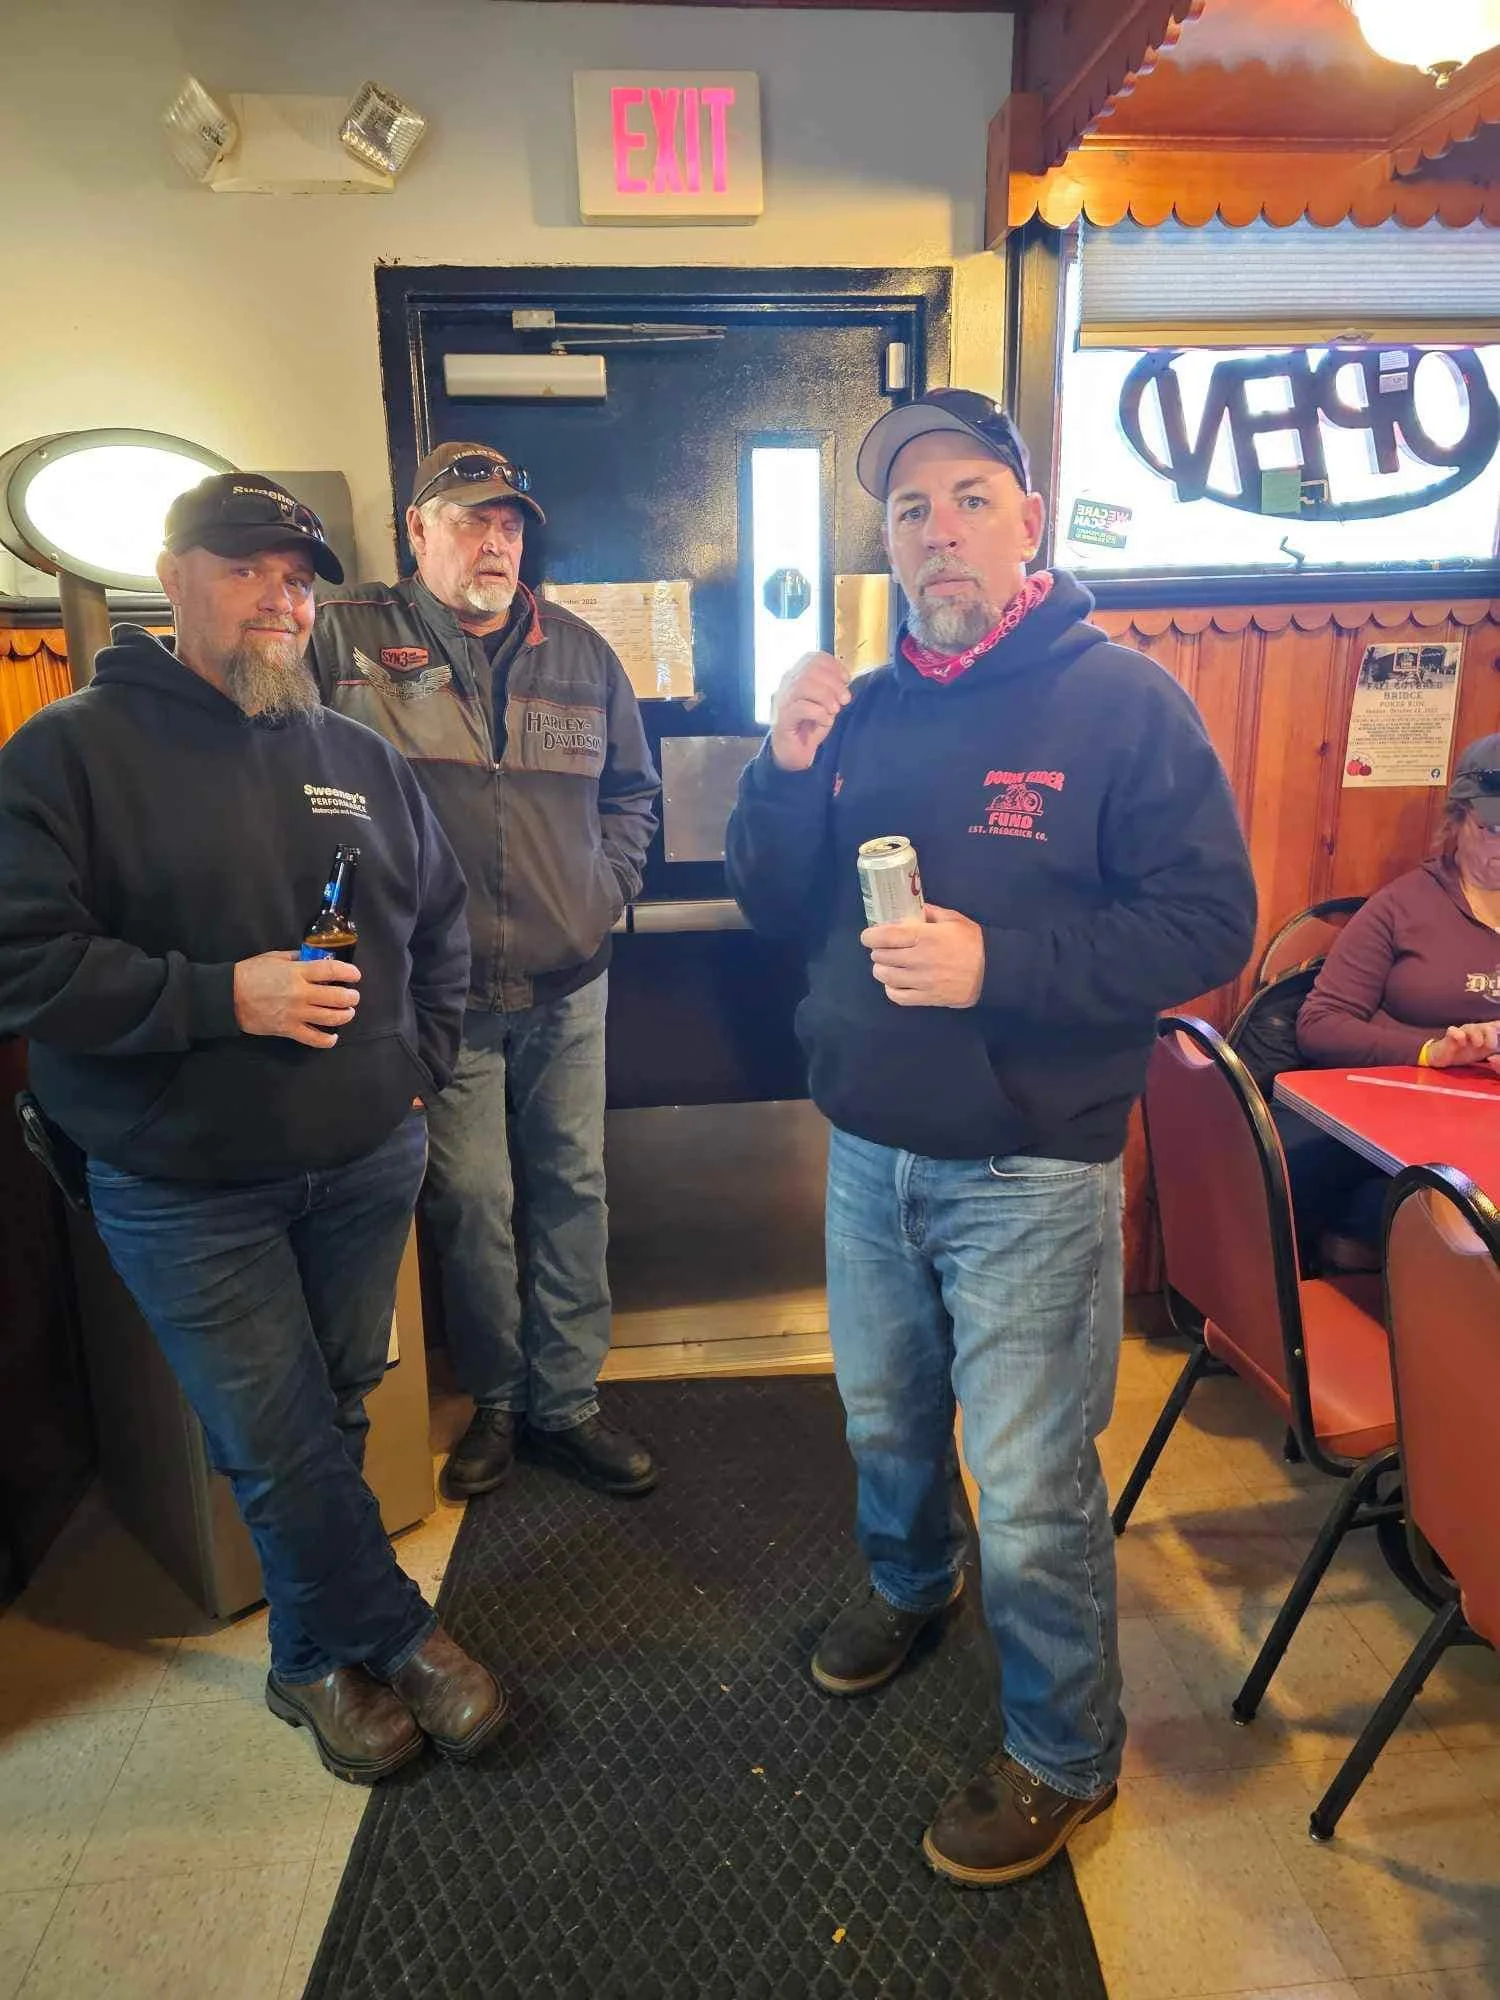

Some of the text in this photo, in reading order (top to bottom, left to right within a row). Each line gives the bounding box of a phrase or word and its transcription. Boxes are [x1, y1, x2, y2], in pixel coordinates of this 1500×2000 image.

[611, 86, 736, 194] EXIT
[382, 651, 409, 667] SYN3
[1384, 691, 1423, 701] BRIDGE
[526, 711, 592, 734] HARLEY-
[303, 783, 367, 804] Sweeney's
[311, 797, 368, 813] PERFORMANCE
[988, 812, 1033, 829] FUND
[968, 825, 1048, 841] EST. FREDERICK CO.
